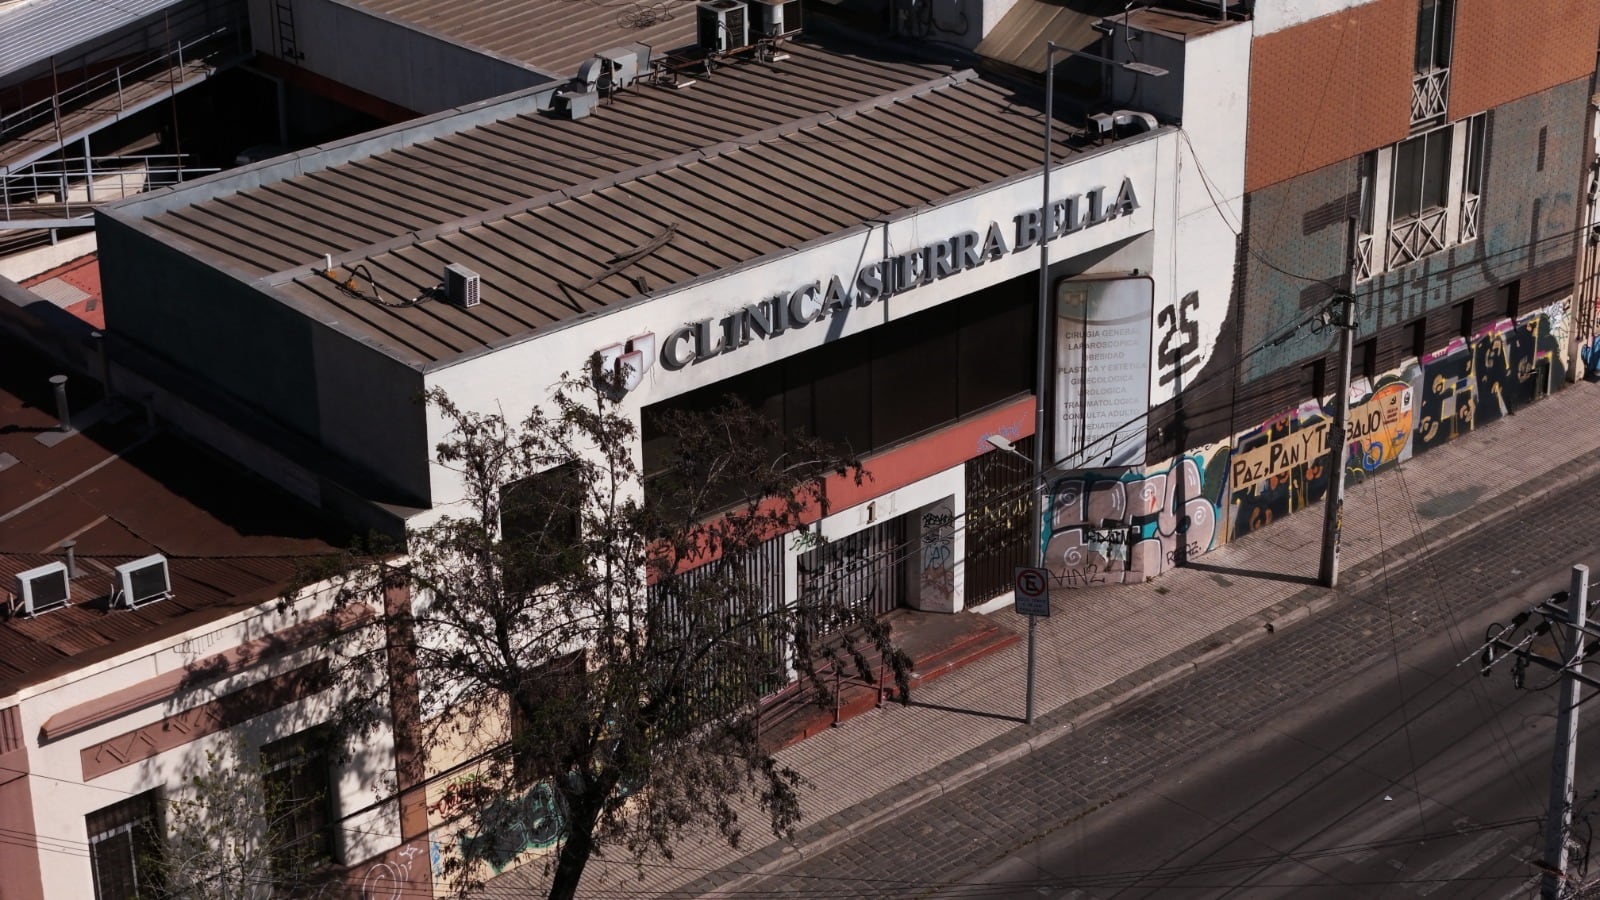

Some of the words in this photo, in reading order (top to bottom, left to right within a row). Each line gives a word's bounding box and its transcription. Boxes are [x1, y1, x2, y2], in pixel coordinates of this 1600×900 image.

[660, 274, 852, 371] CLINICA
[856, 220, 1010, 309] SIERRA
[1012, 175, 1141, 255] BELLA
[1302, 430, 1314, 460] Y
[1024, 574, 1037, 591] E
